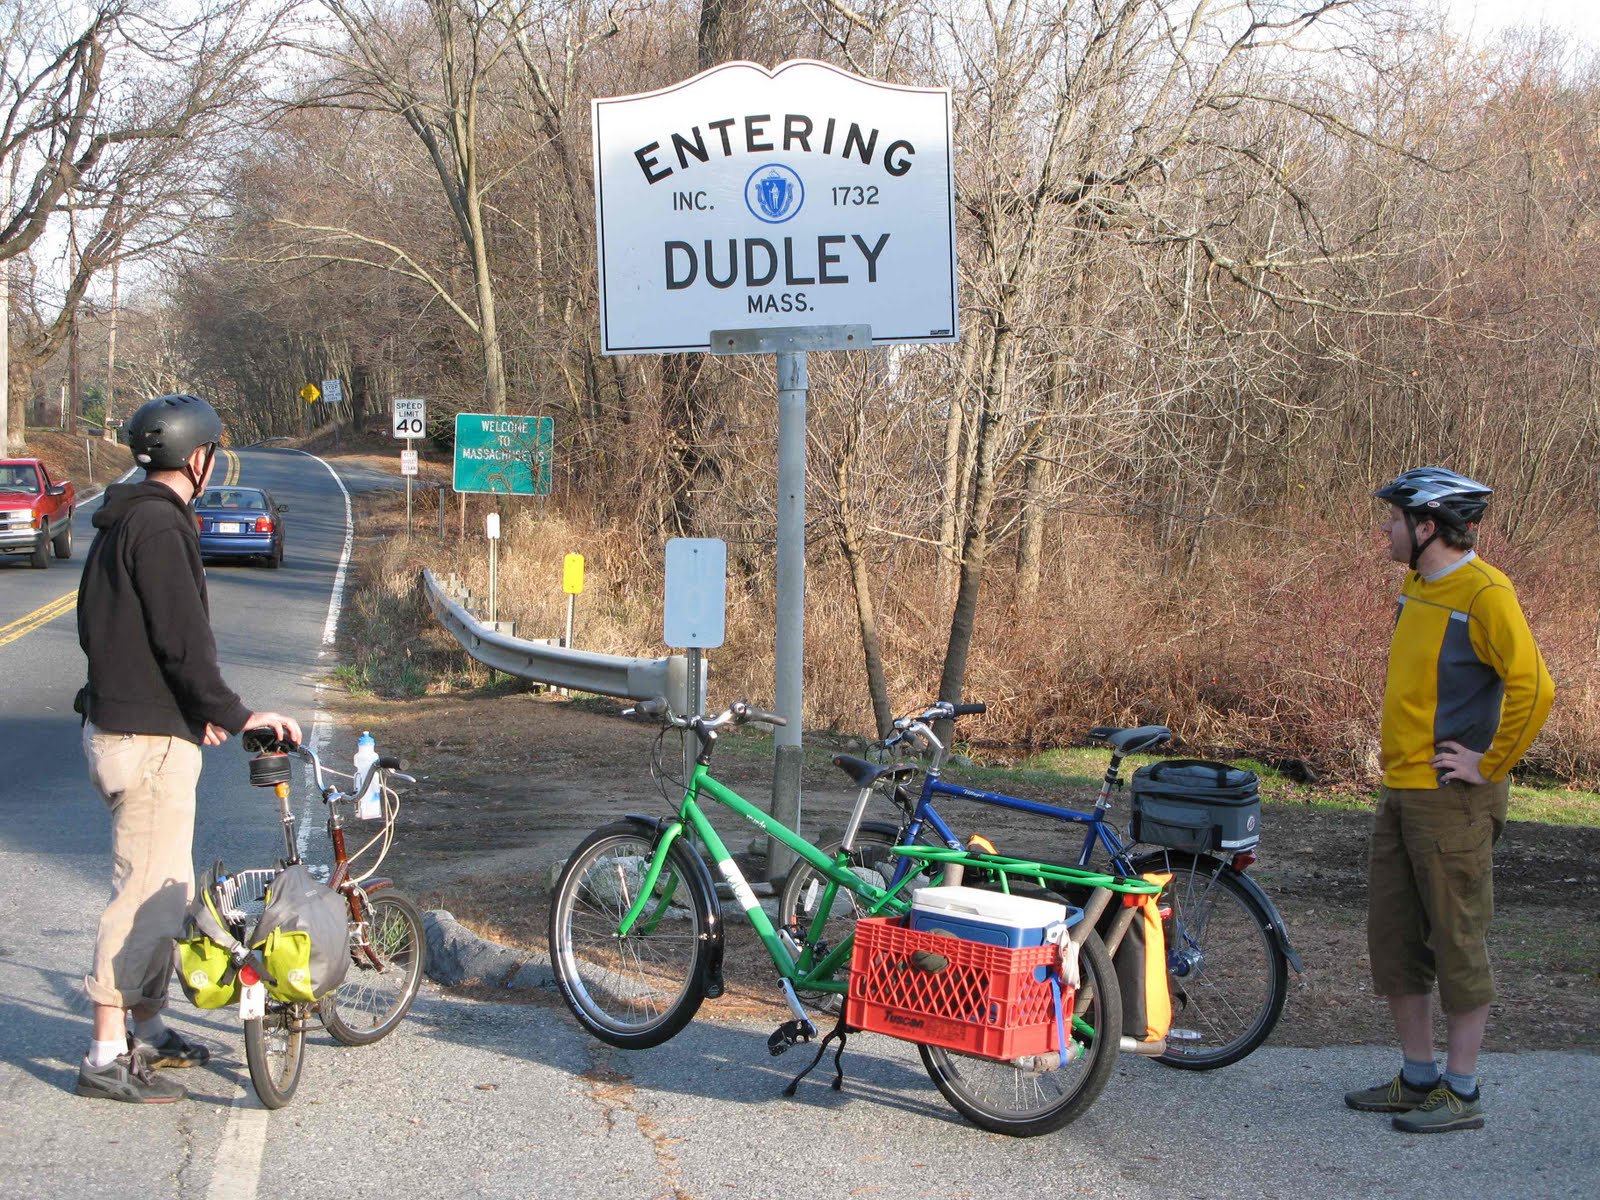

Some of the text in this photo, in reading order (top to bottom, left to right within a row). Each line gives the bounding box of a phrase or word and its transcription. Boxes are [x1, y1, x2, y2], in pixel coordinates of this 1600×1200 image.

[634, 114, 916, 185] ENTERING
[673, 186, 879, 211] INC. 1732
[665, 233, 891, 290] DUDLEY
[748, 293, 814, 314] MASS.
[396, 419, 423, 433] 40
[481, 420, 528, 433] WELCOME
[498, 435, 511, 447] TO
[462, 448, 545, 463] MASSACHSES
[884, 1009, 925, 1028] Tuscan
